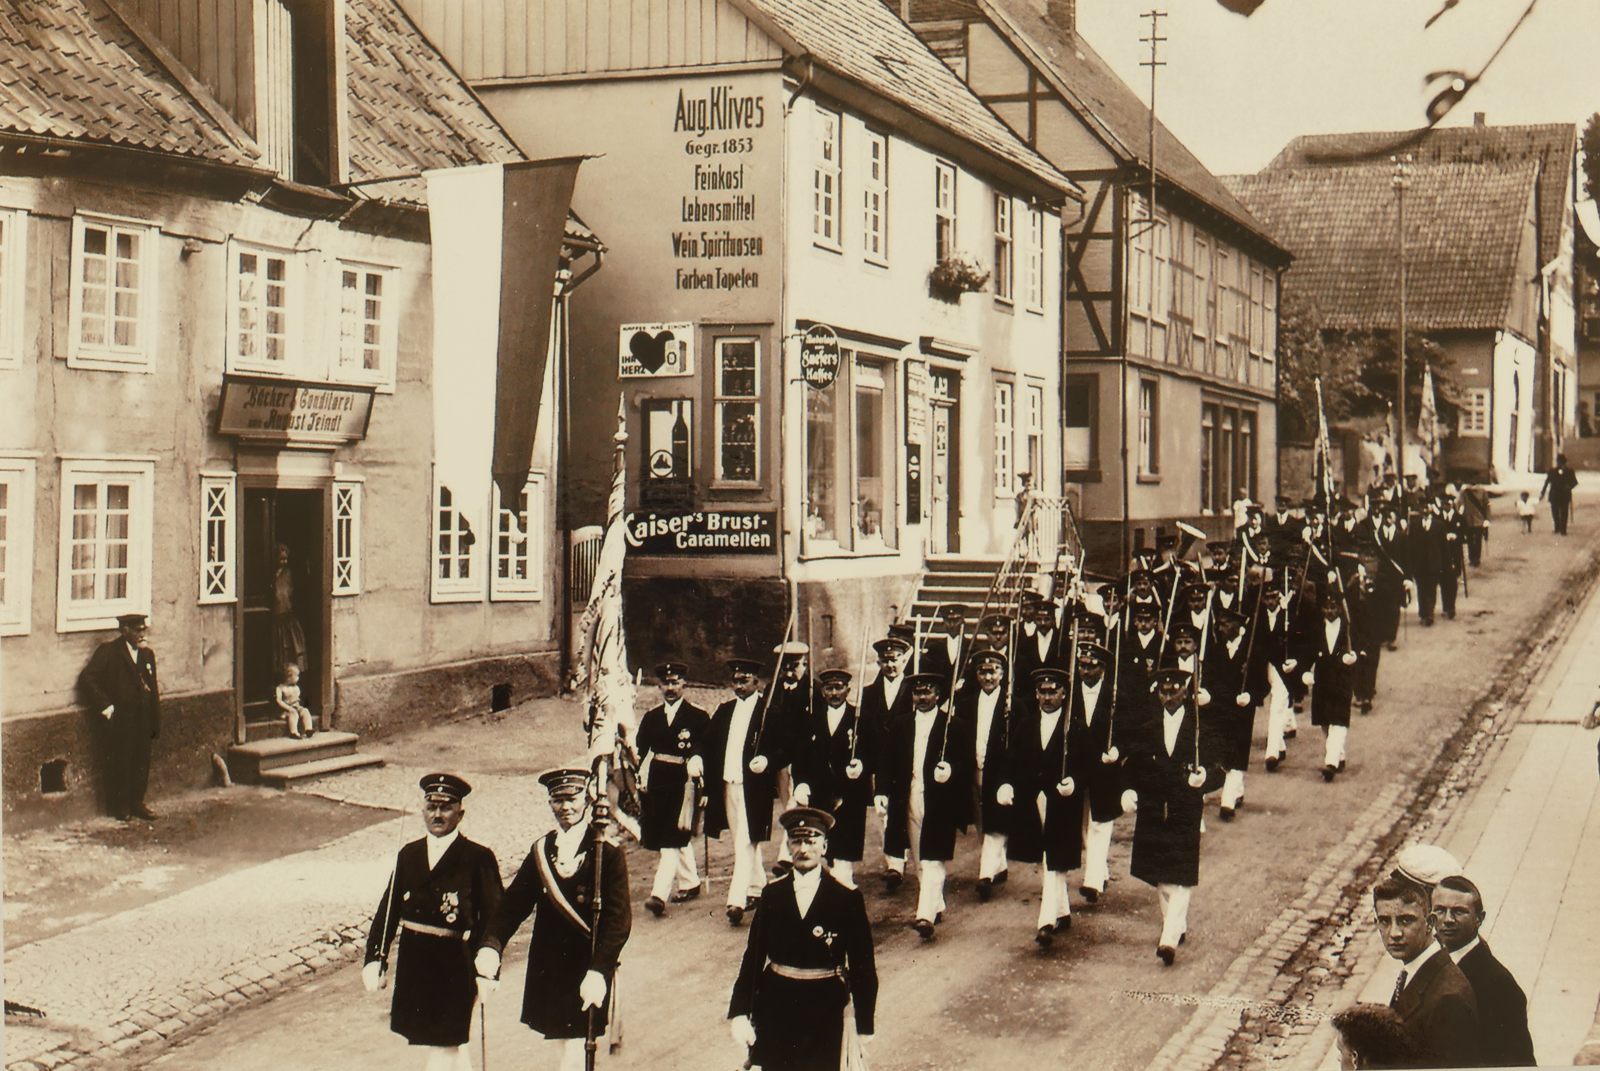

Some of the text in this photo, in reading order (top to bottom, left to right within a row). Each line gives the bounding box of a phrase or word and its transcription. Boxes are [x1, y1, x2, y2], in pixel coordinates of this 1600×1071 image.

[694, 164, 743, 191] Feinkost
[682, 194, 755, 222] Lebensmittel
[672, 230, 763, 260] Wein Spirituosen
[676, 267, 759, 291] Farben Tapeten
[622, 365, 646, 375] HERZ
[675, 532, 771, 549] Caramellen
